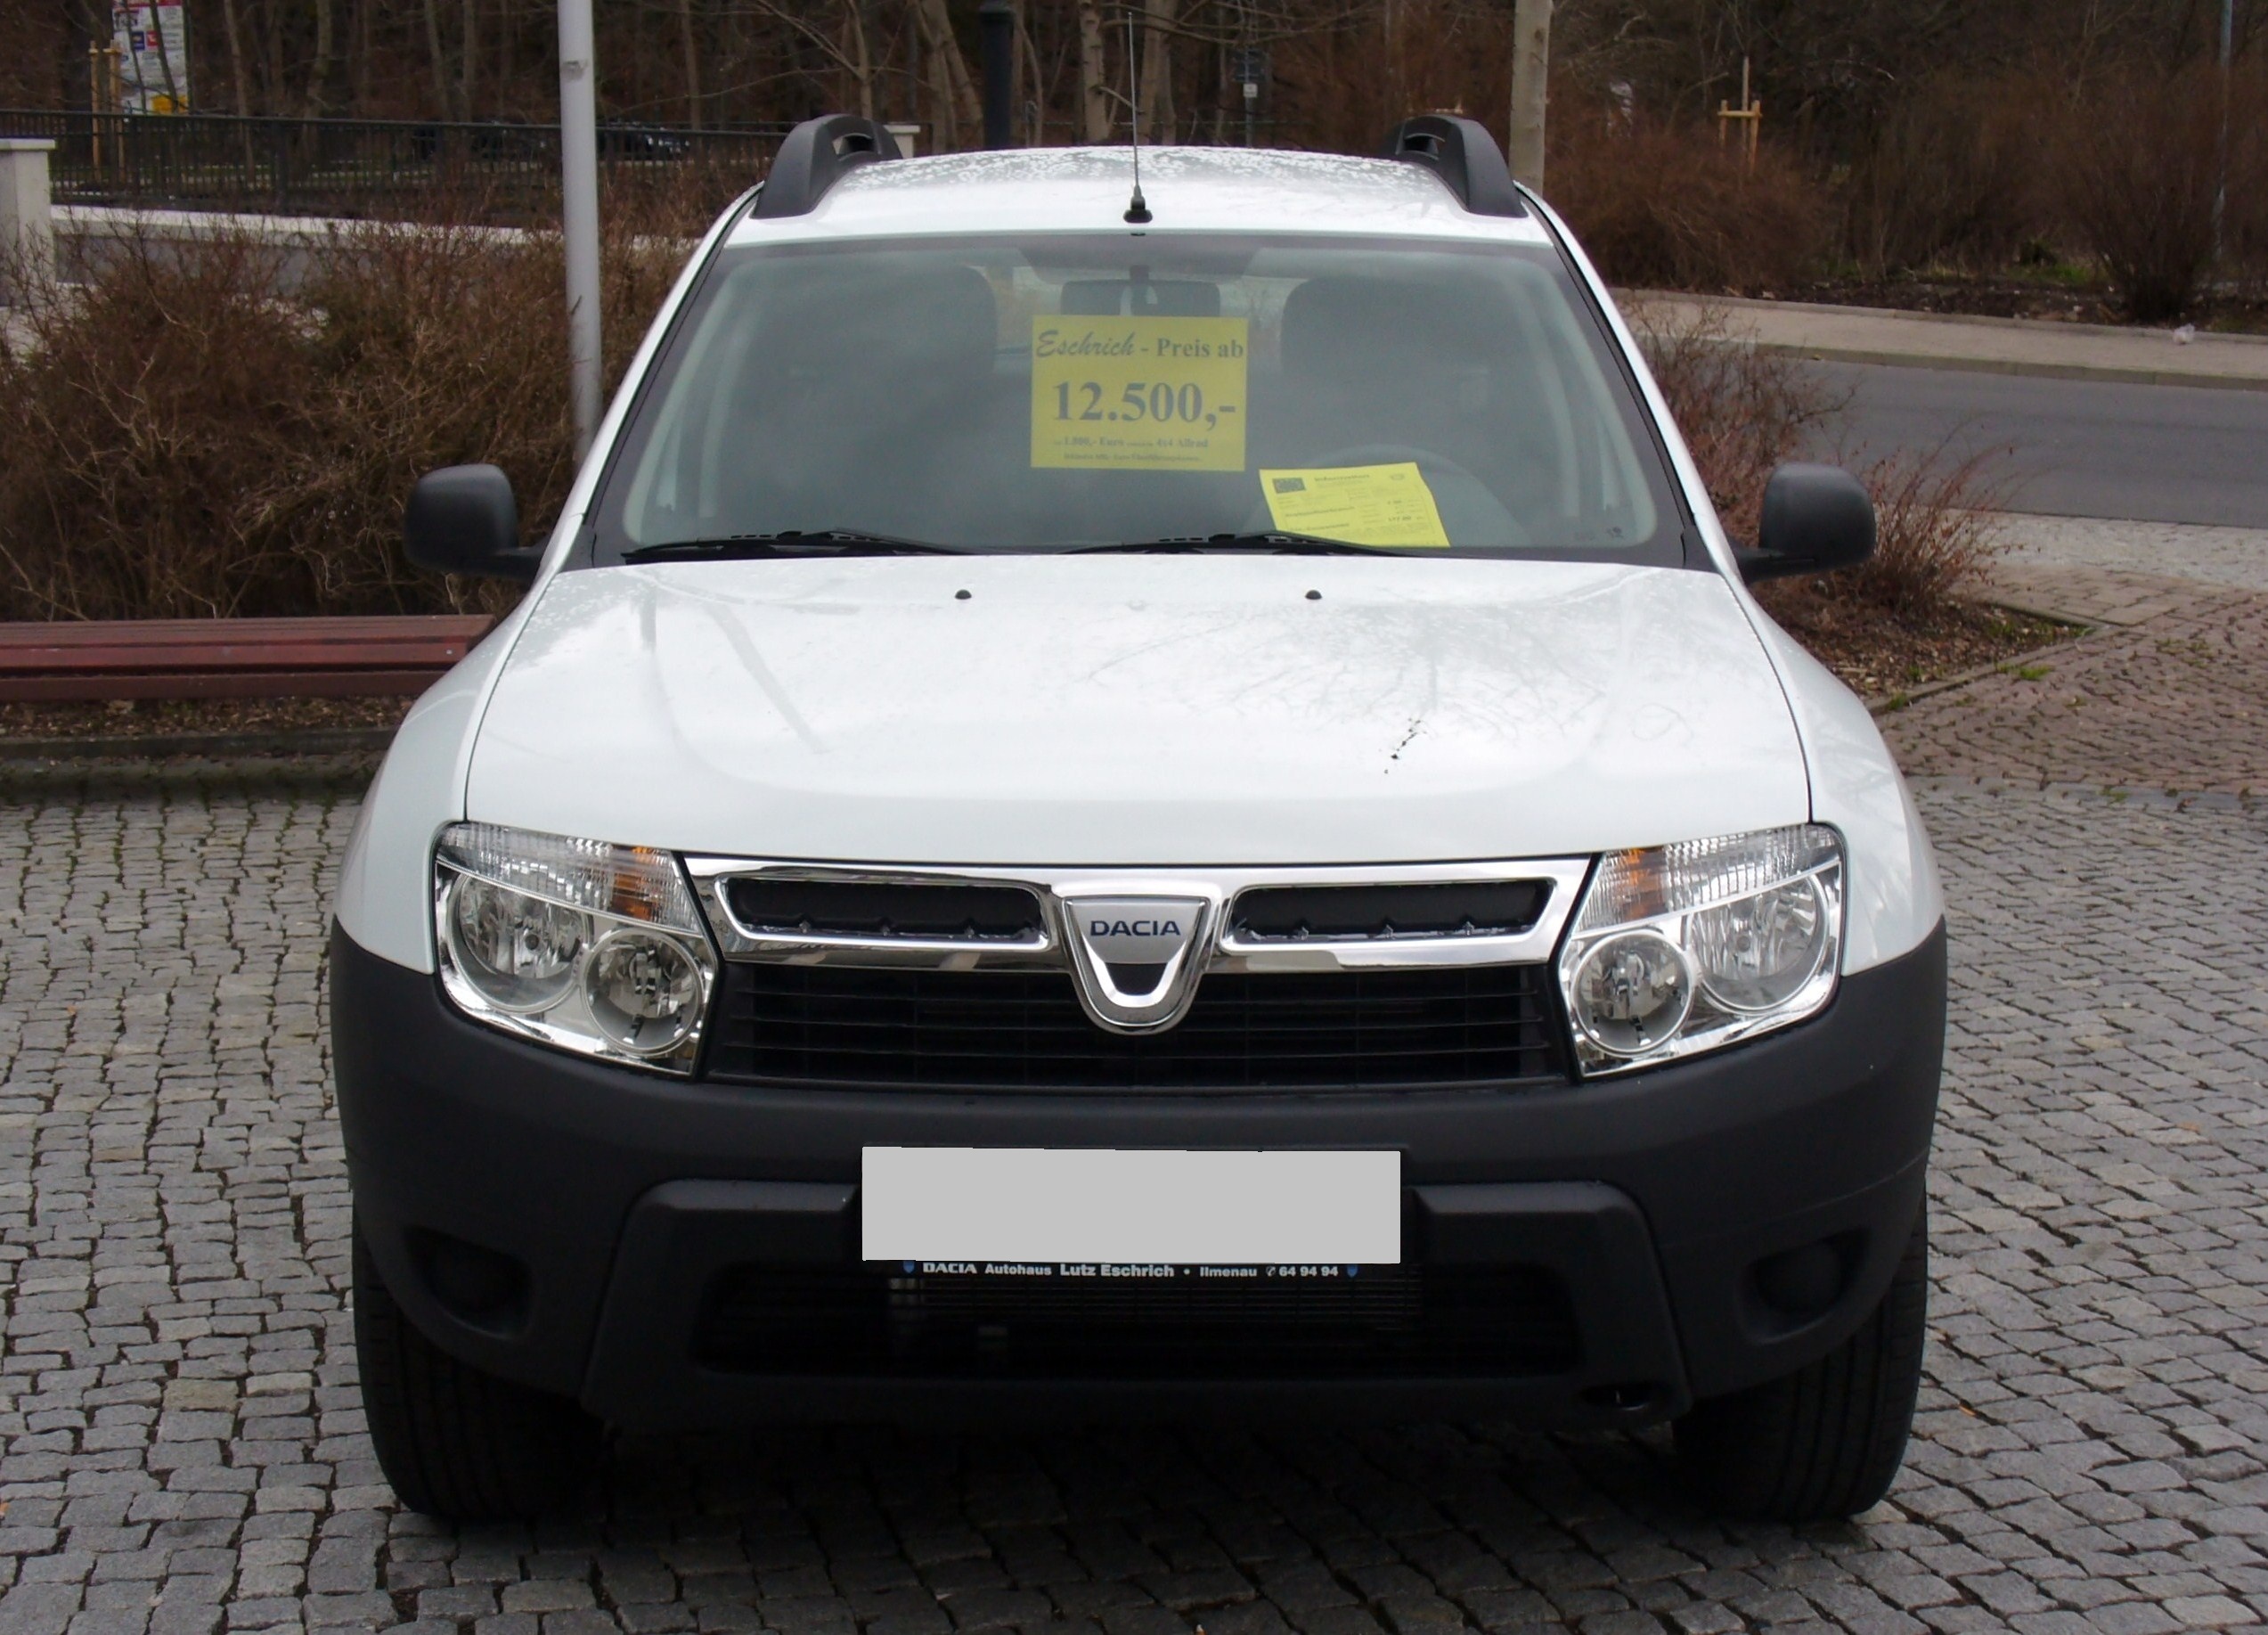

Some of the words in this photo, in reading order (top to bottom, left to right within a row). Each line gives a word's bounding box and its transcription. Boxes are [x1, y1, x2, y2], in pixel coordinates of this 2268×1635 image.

[1035, 329, 1136, 358] Eschrich
[1157, 338, 1211, 357] Preis
[1218, 339, 1244, 359] ab
[1053, 380, 1236, 430] 12.500,-
[1089, 920, 1181, 936] DACIA
[922, 1262, 978, 1274] DACIA
[984, 1263, 1052, 1276] Autohaus
[1059, 1263, 1097, 1277] Lutz
[1100, 1264, 1175, 1278] Eschrich
